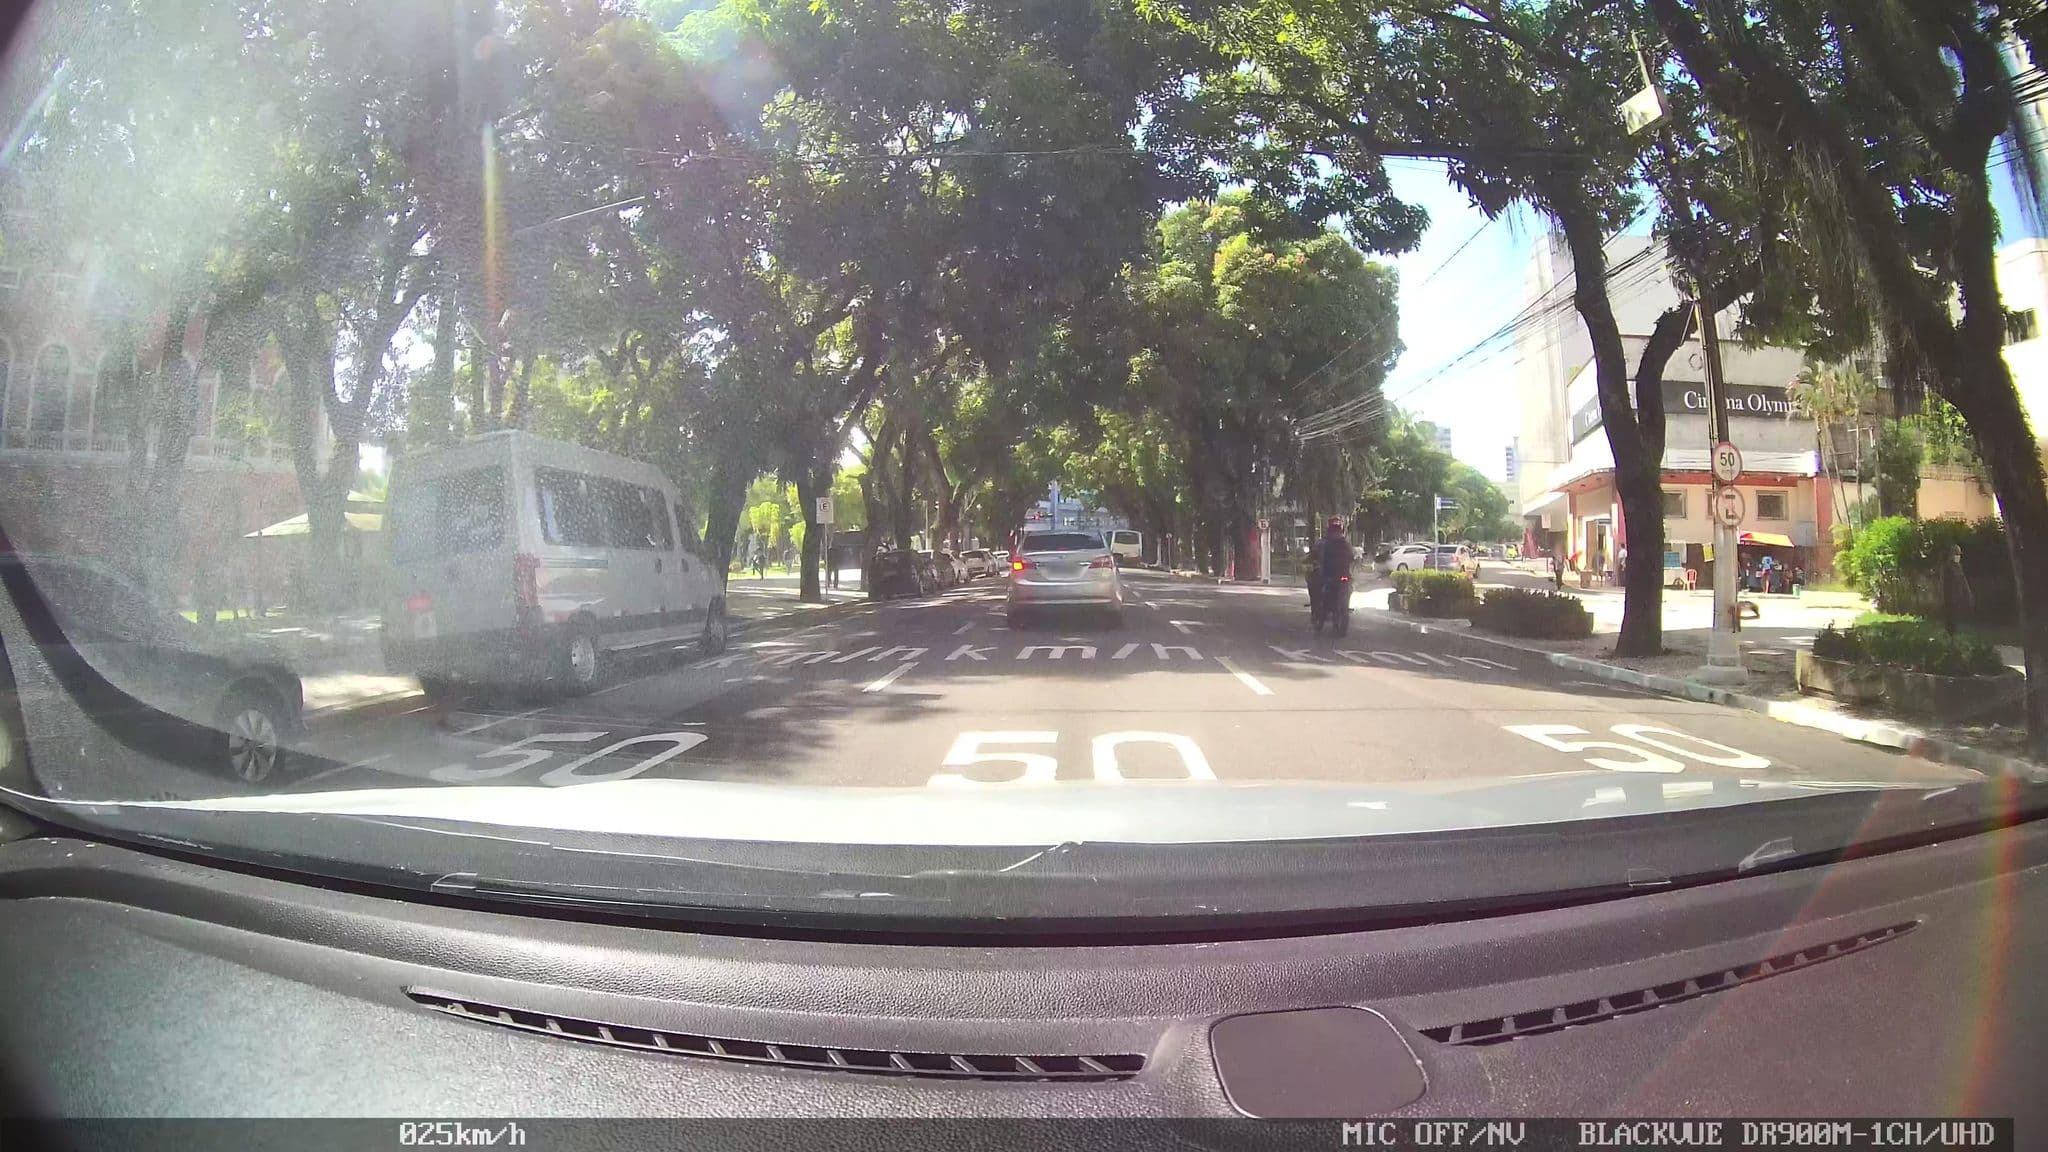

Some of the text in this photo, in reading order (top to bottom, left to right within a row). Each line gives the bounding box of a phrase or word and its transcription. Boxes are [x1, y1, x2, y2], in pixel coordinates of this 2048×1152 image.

[1684, 391, 1745, 411] Cima
[1720, 452, 1735, 466] 50
[944, 643, 1204, 660] km/h
[1267, 645, 1519, 670] km/h
[429, 732, 709, 788] 50
[926, 730, 1218, 784] 50
[1501, 724, 1771, 773] 50
